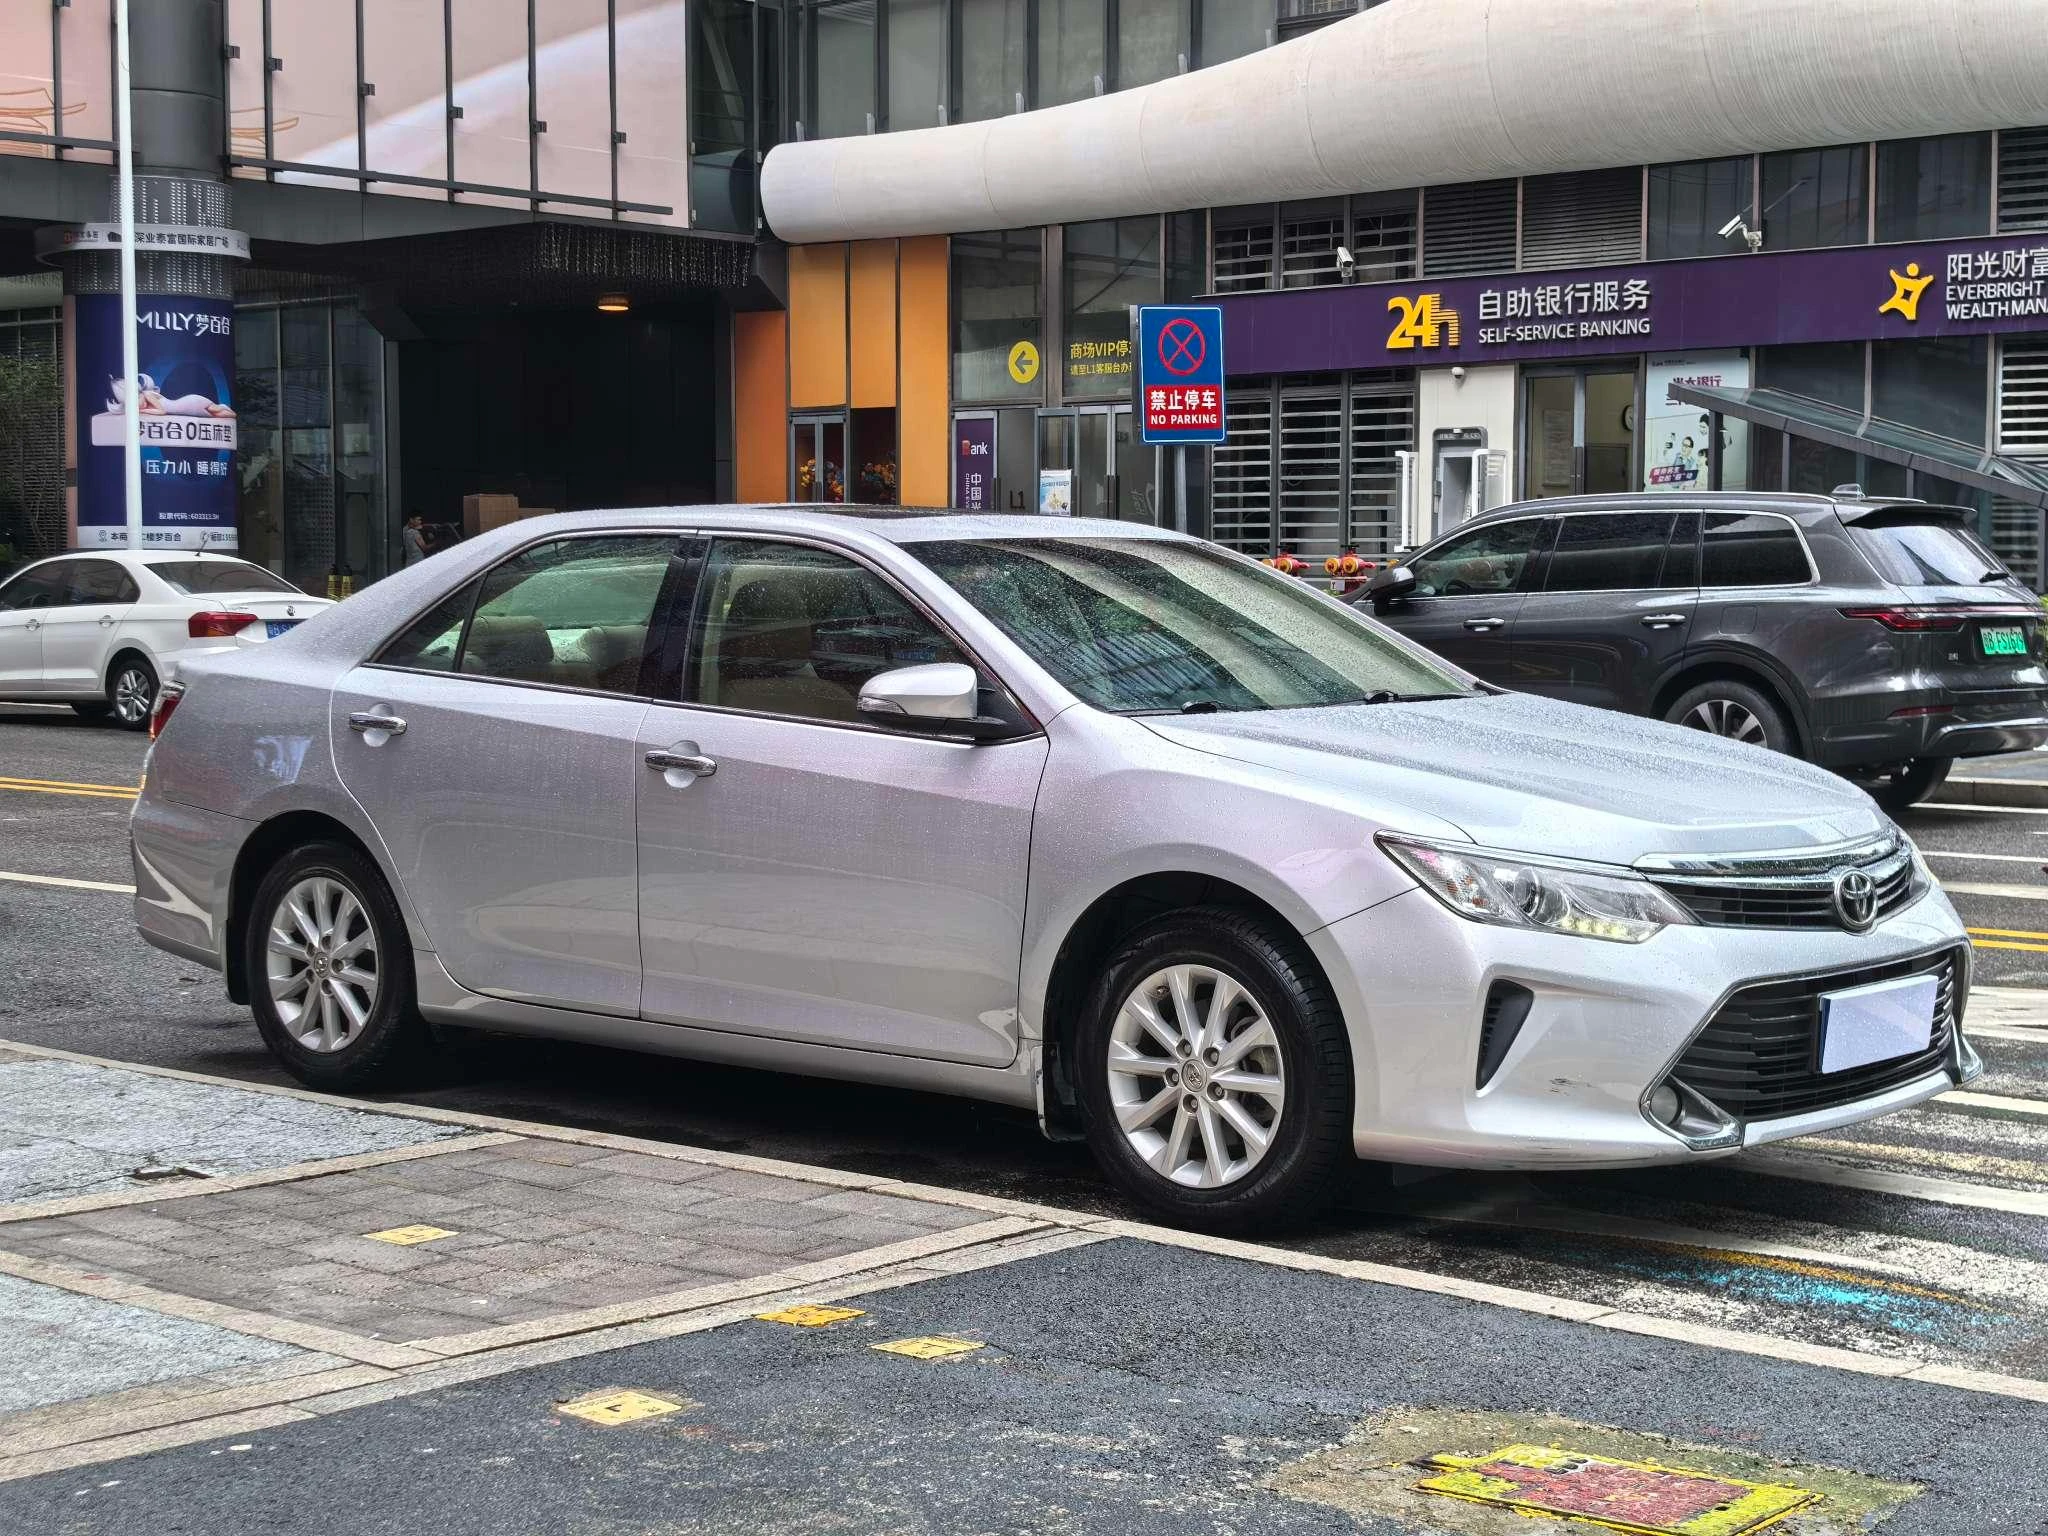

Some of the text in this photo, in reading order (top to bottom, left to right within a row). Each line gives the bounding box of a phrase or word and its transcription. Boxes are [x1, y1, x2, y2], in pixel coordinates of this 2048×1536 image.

[1479, 278, 1650, 320] 自助银行服务
[1946, 280, 2045, 301] EVERBRIGHT
[2011, 297, 2048, 316] MAN
[1386, 293, 1461, 349] 24h
[1478, 317, 1651, 344] SELF-SERVICE BANKING
[1151, 390, 1217, 411] 禁止停车
[1151, 413, 1217, 425] NO PARKING
[962, 439, 988, 456] Bank
[146, 459, 192, 475] 压力小
